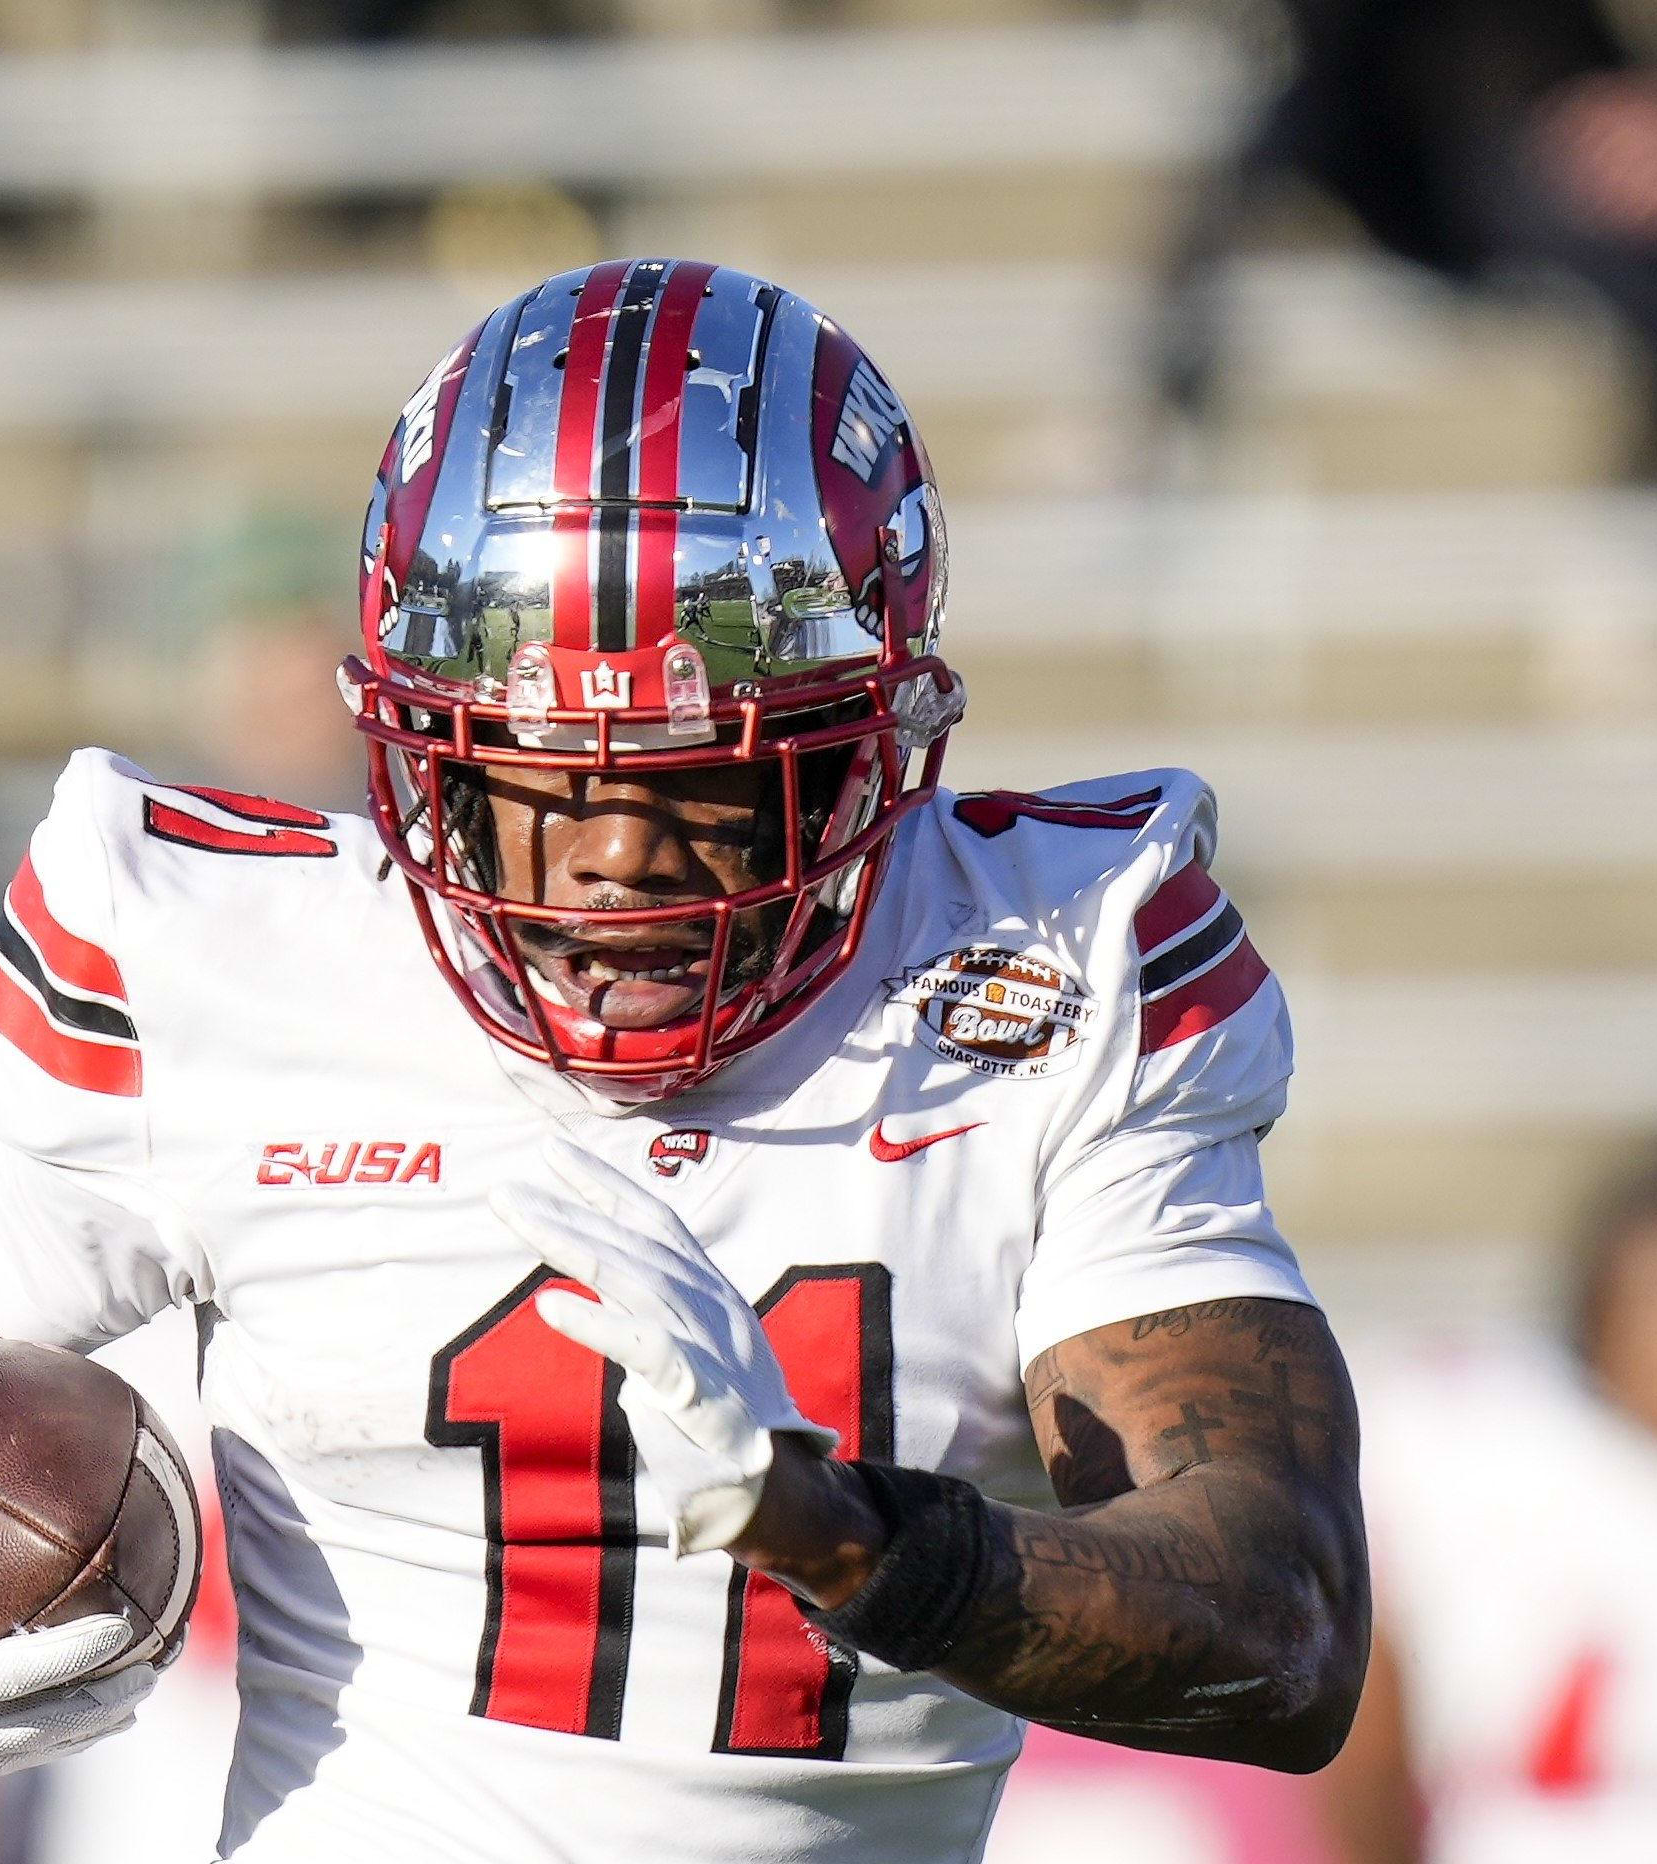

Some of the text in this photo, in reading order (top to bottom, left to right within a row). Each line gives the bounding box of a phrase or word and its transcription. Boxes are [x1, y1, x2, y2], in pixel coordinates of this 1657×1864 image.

[912, 975, 1095, 1023] FAMOUS TOASTERY
[947, 1006, 1050, 1047] Bowl
[1029, 1062, 1049, 1074] NC
[424, 1262, 896, 1762] 11
